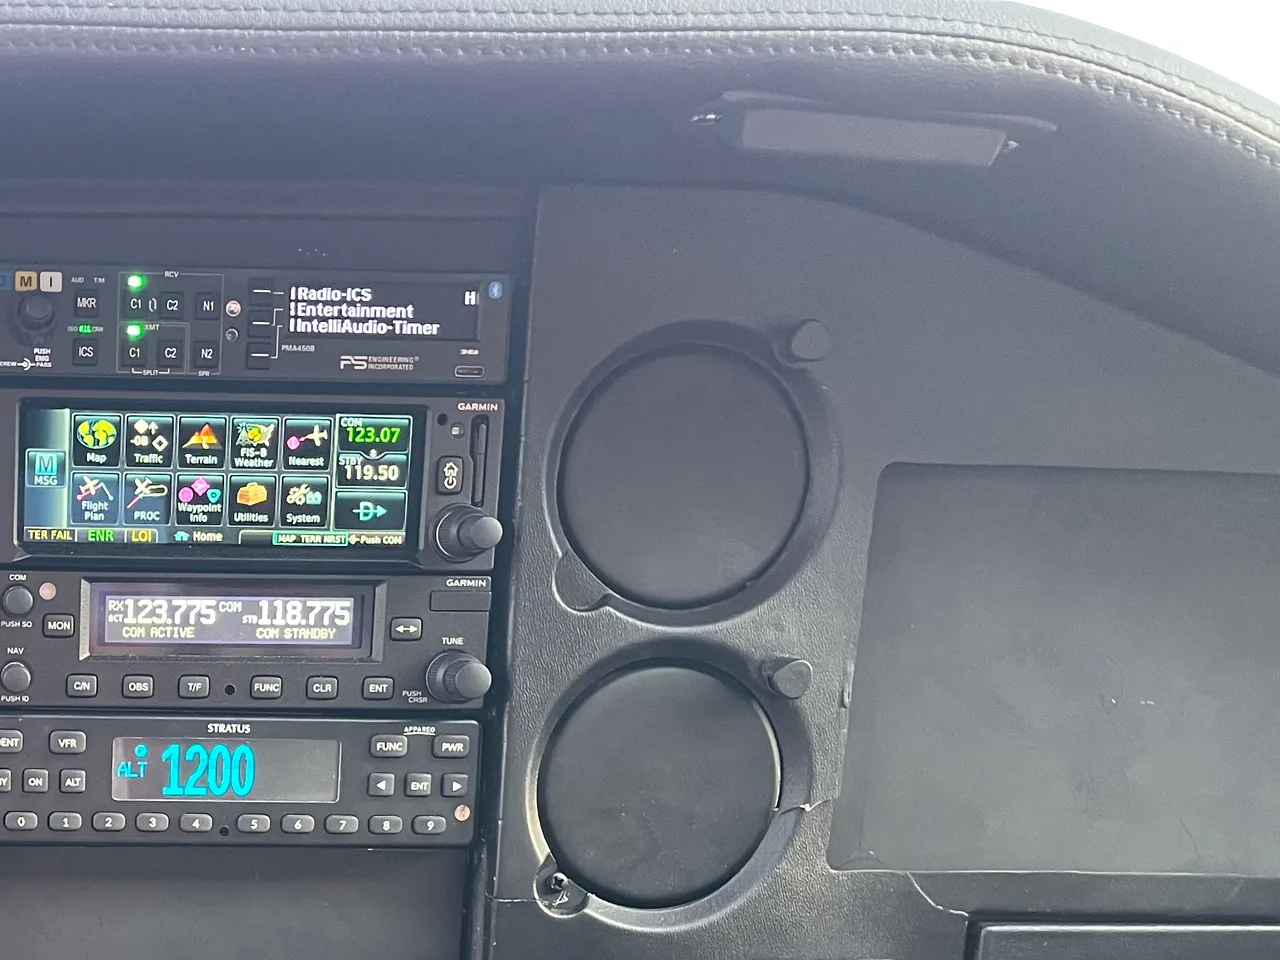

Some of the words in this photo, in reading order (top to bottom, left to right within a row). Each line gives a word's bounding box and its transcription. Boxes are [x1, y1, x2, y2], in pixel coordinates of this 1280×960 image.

[298, 287, 372, 301] Radio-ICS
[77, 298, 96, 308] MKR
[130, 299, 142, 309] C1
[166, 300, 178, 310] C2
[203, 301, 214, 311] N1
[297, 304, 414, 319] Entertainment
[297, 320, 440, 335] IntelliAudio-Timer
[79, 347, 94, 357] ICS
[201, 349, 213, 359] N2
[458, 403, 498, 411] GARMIN
[346, 427, 401, 443] 123.07
[240, 448, 267, 457] FIS-B
[86, 453, 107, 464] Map
[134, 454, 164, 464] Traffic
[185, 455, 218, 465] Terrain
[234, 458, 274, 468] Weather
[288, 457, 324, 467] Nearest
[344, 465, 399, 481] 119.50
[34, 476, 57, 485] MSG
[82, 501, 108, 512] Flight
[178, 503, 221, 514] Waypoint
[85, 511, 104, 521] Plan
[134, 511, 160, 520] PROC
[190, 513, 207, 522] Info
[234, 513, 269, 522] Utilities
[286, 514, 320, 524] System
[28, 530, 48, 540] TER
[51, 530, 72, 540] FAIL
[88, 530, 114, 542] ENR
[193, 531, 223, 542] Home
[124, 600, 216, 625] 123.775
[258, 600, 351, 626] 118.775
[48, 622, 70, 630] MON
[122, 627, 145, 638] COM
[150, 627, 195, 638] ACTIVE
[256, 629, 280, 638] COM
[284, 629, 336, 640] STANDBY
[74, 682, 90, 691] C/N
[128, 682, 148, 691] OBS
[254, 684, 280, 692] FUNC
[313, 684, 331, 692] CLR
[369, 685, 388, 693] ENT
[207, 723, 250, 734] STRATUS
[59, 738, 76, 749] VFR
[376, 741, 403, 752] FUNC
[442, 742, 464, 753] PWR
[117, 761, 148, 778] ALT
[162, 744, 256, 796] 1200
[65, 777, 81, 787] ALT
[410, 781, 428, 791] ENT
